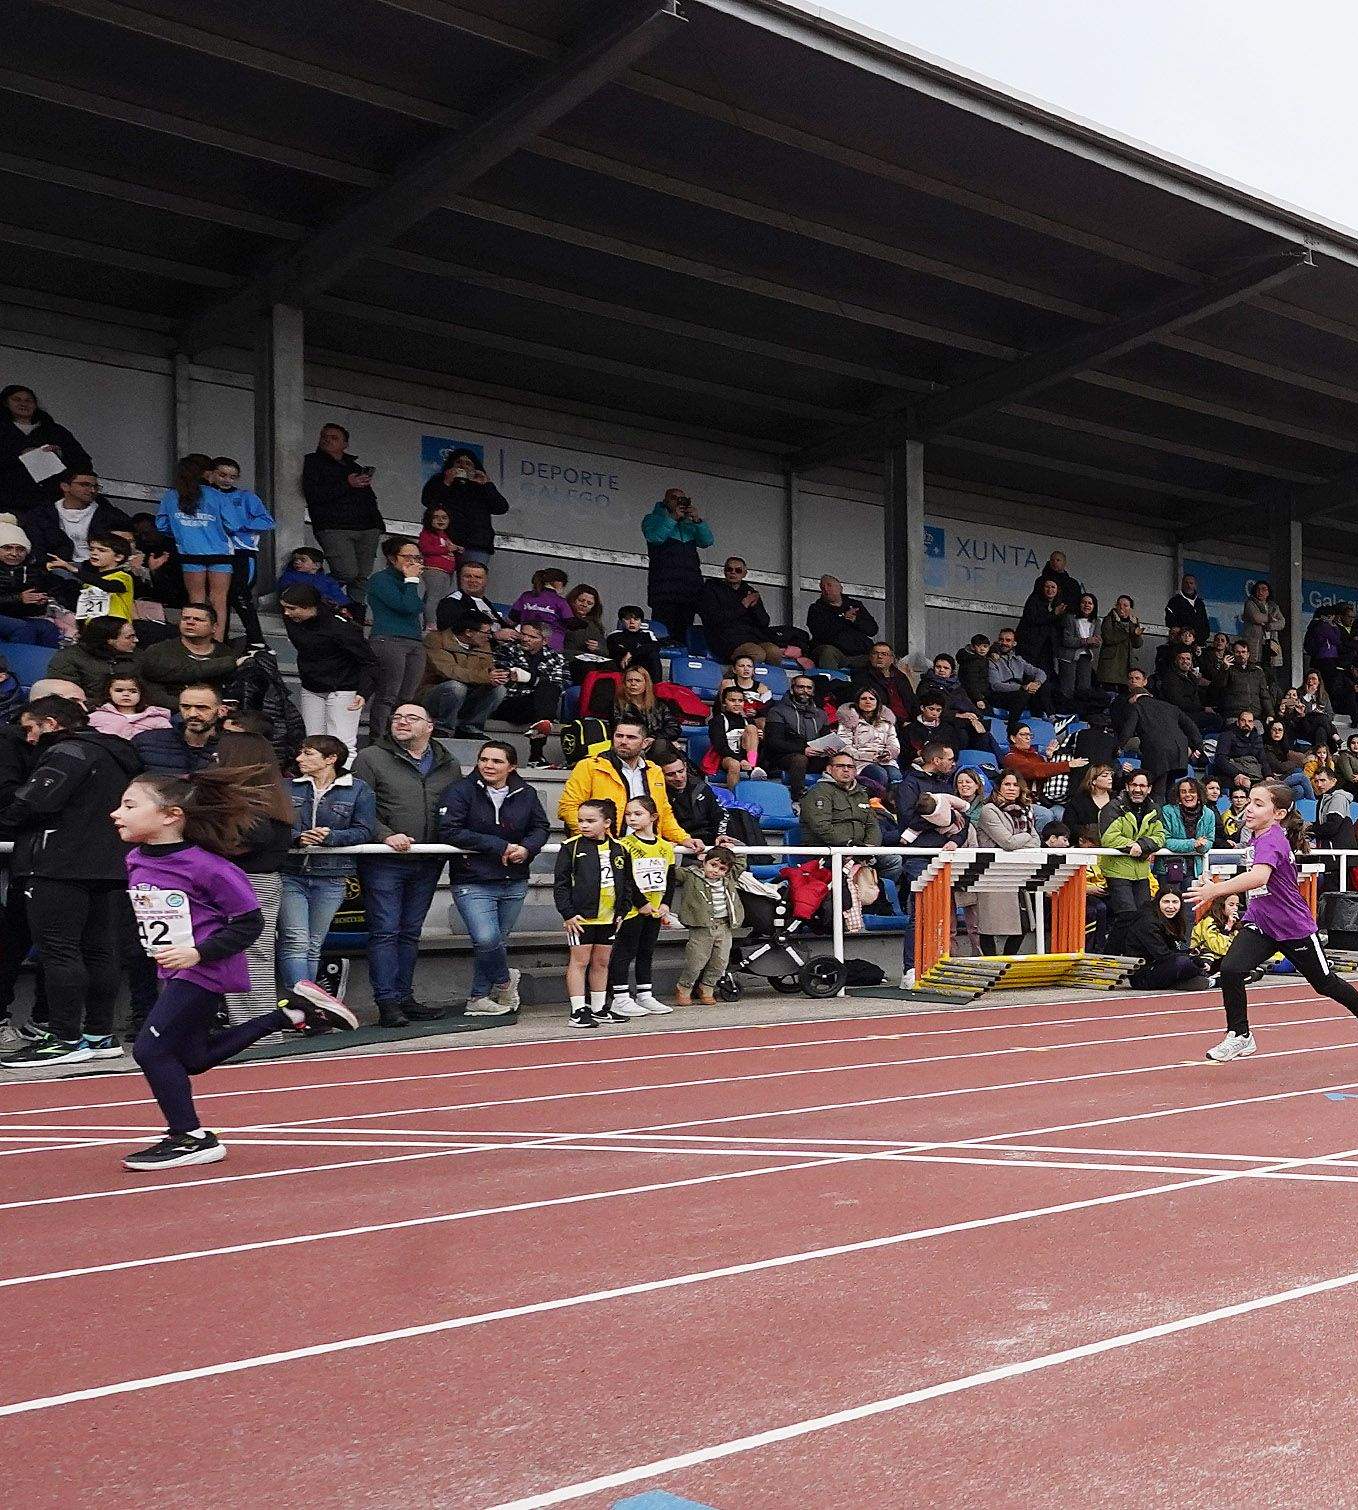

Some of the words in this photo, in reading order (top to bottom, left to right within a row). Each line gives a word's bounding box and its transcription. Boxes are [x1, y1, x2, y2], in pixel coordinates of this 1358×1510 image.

[521, 460, 620, 491] DEPORTE
[956, 537, 1040, 570] XUNTA
[642, 871, 665, 886] 13
